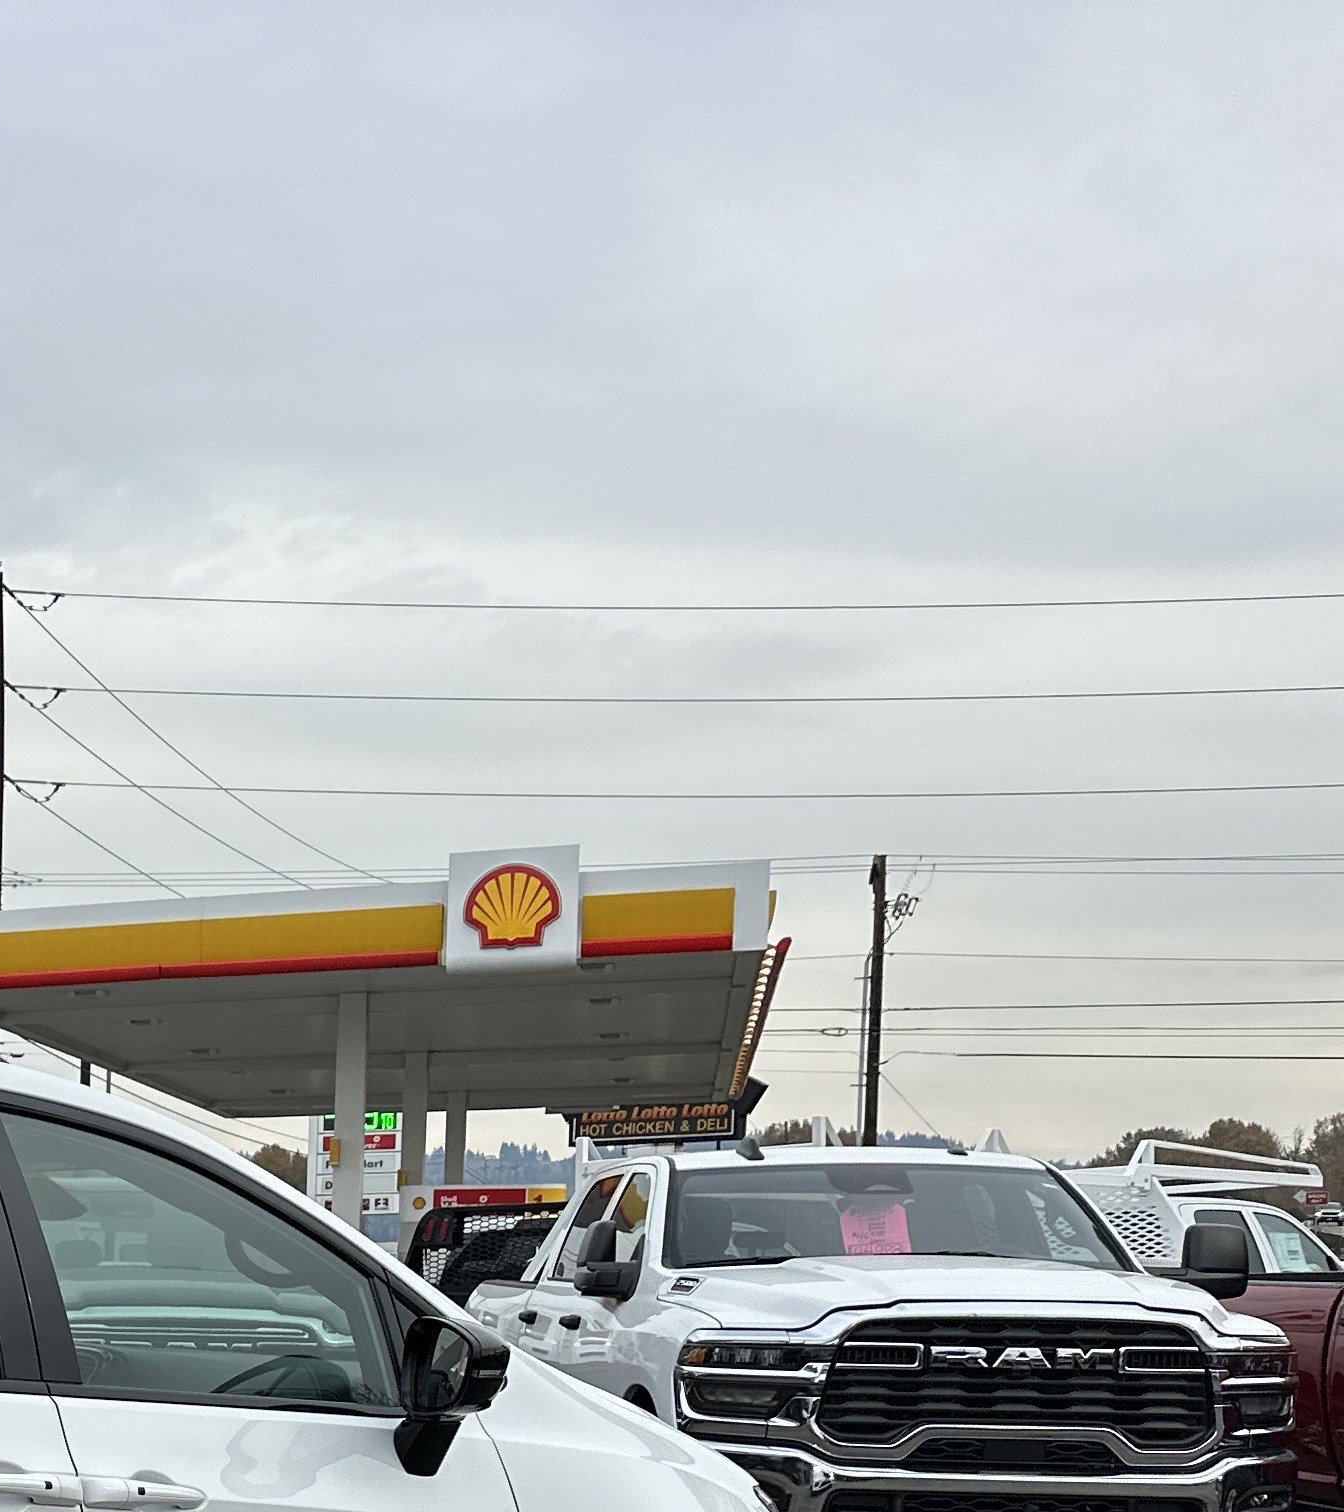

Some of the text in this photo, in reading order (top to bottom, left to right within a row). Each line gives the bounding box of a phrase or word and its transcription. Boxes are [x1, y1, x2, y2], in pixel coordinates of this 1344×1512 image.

[631, 1105, 678, 1121] Lotto
[682, 1102, 729, 1118] Lotto
[580, 1117, 728, 1136] HOT CHICKEN & DELI
[929, 1346, 1116, 1369] RAM
